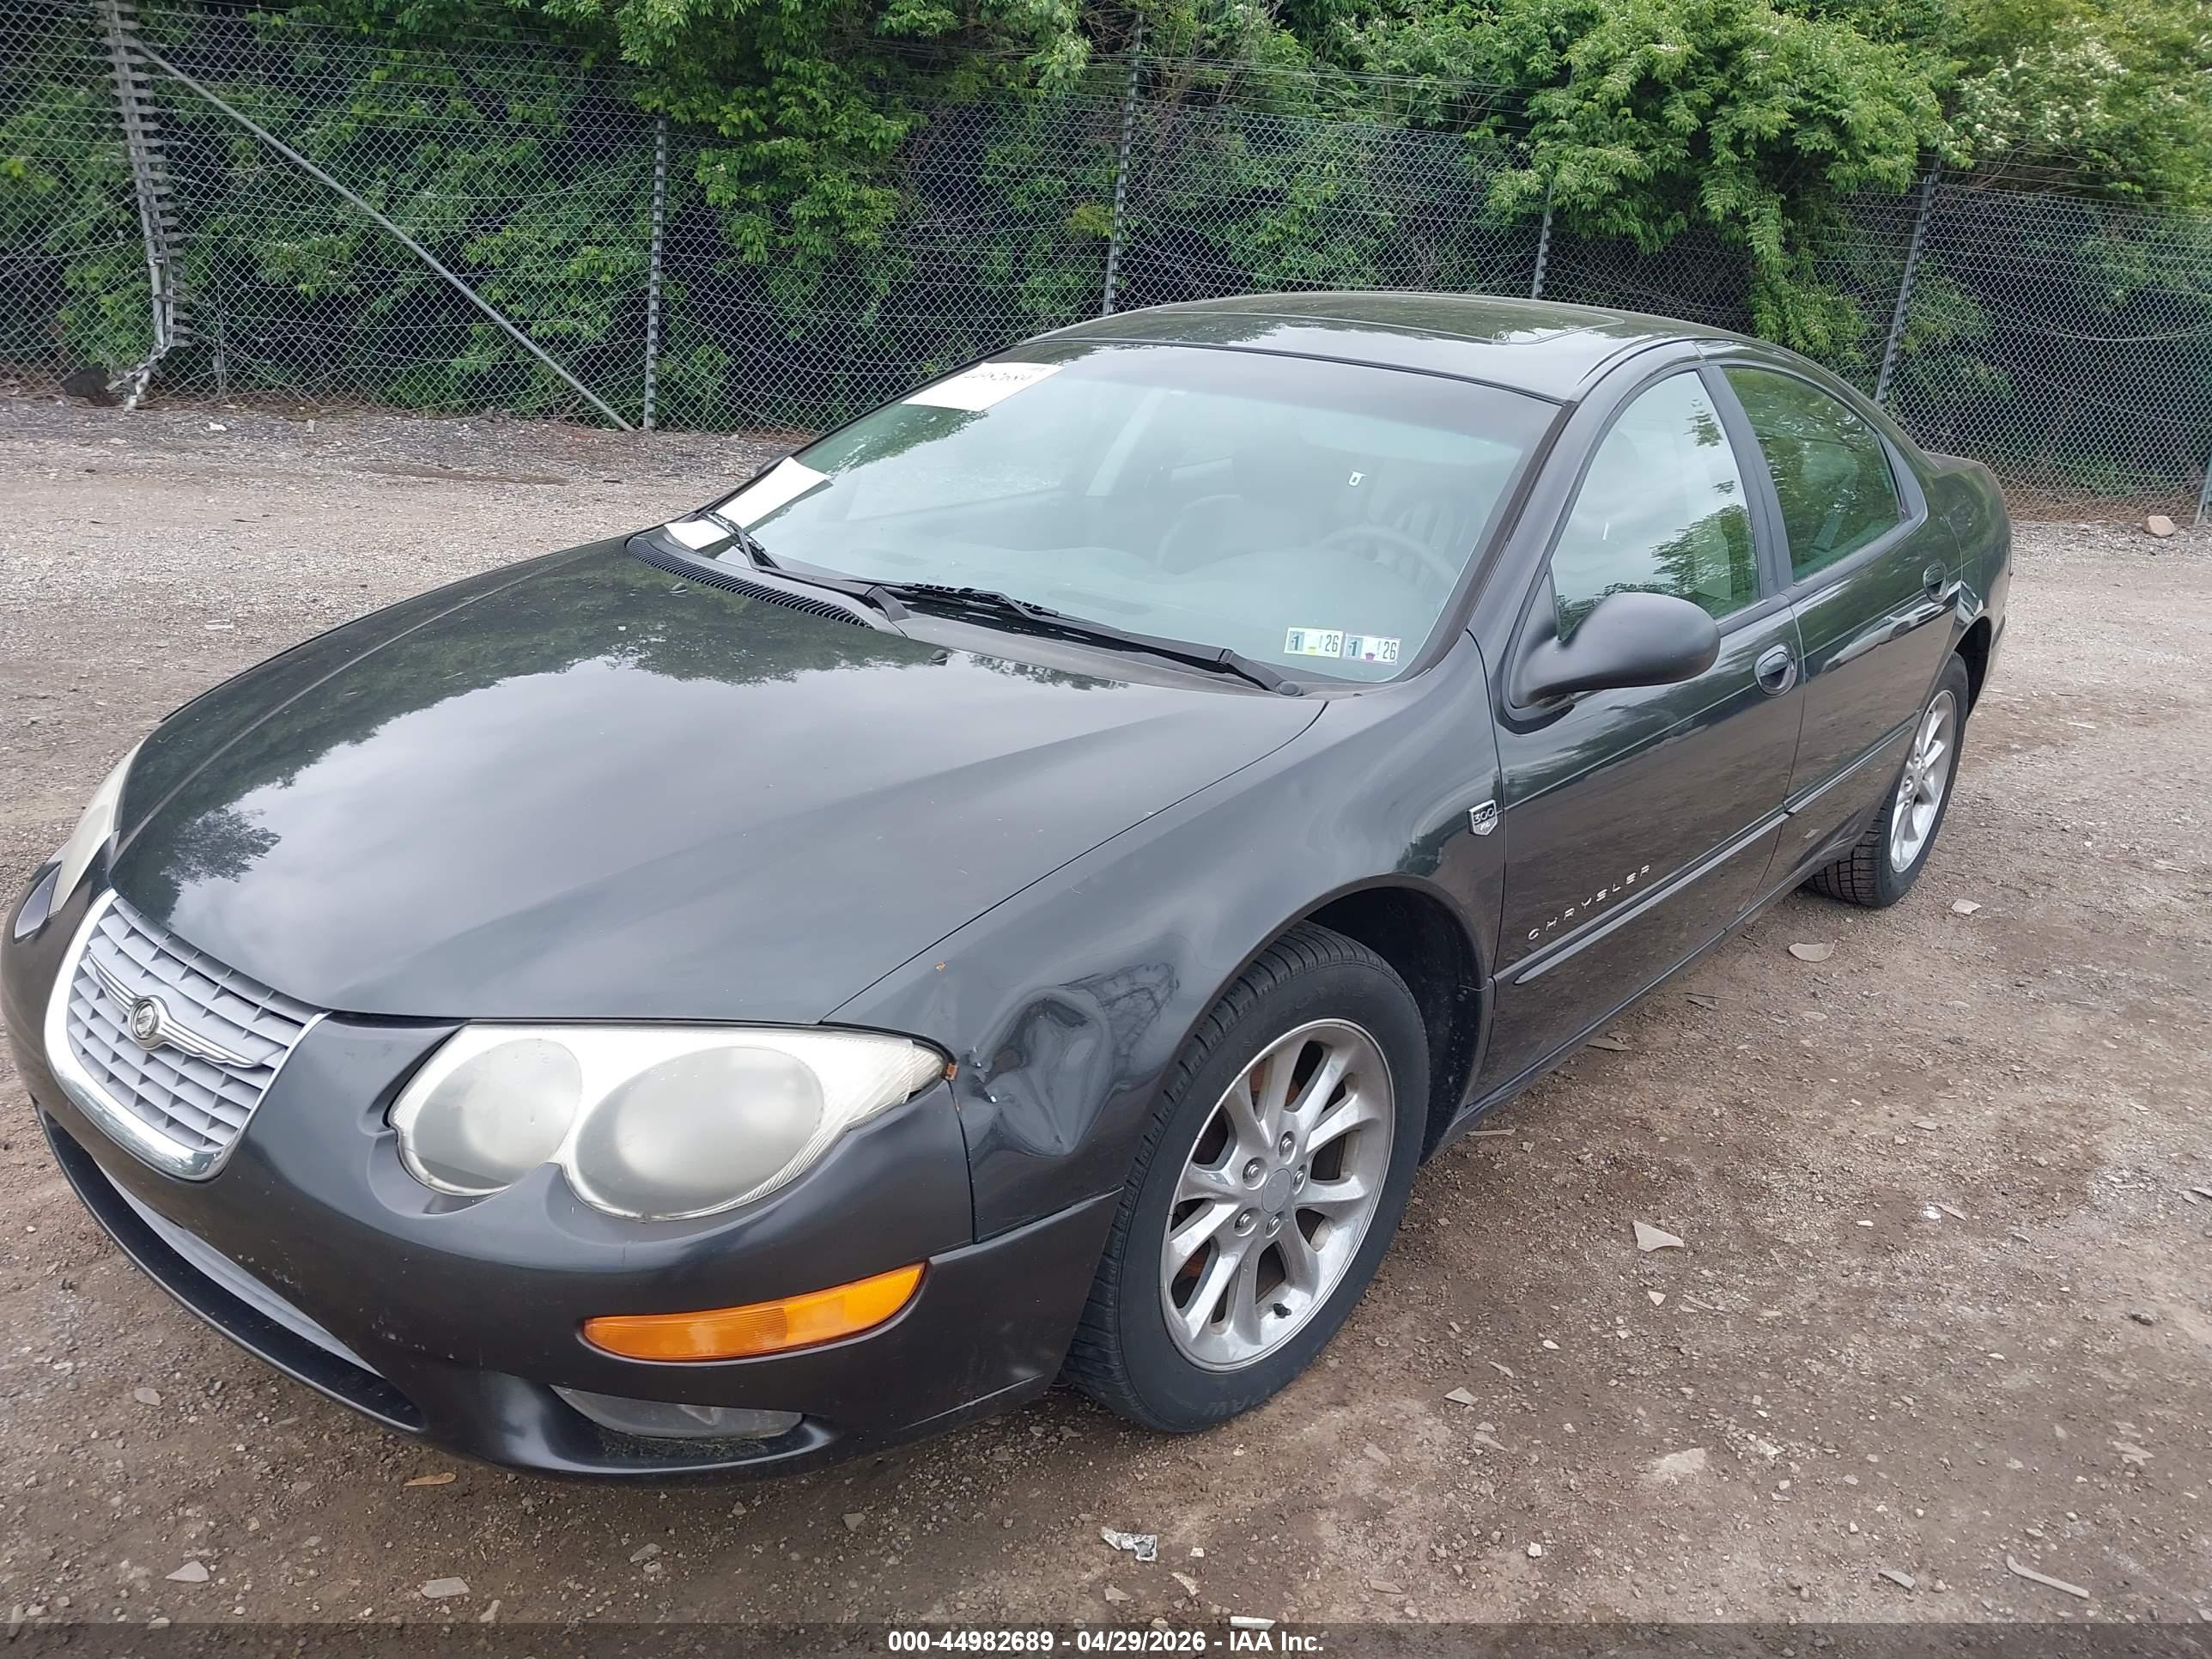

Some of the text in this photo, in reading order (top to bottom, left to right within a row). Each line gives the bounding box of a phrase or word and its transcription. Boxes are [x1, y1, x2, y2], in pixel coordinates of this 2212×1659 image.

[1325, 634, 1340, 653] 26
[1382, 641, 1397, 660] 26
[1473, 807, 1495, 824] 300
[1528, 864, 1650, 940] CHRYSLER
